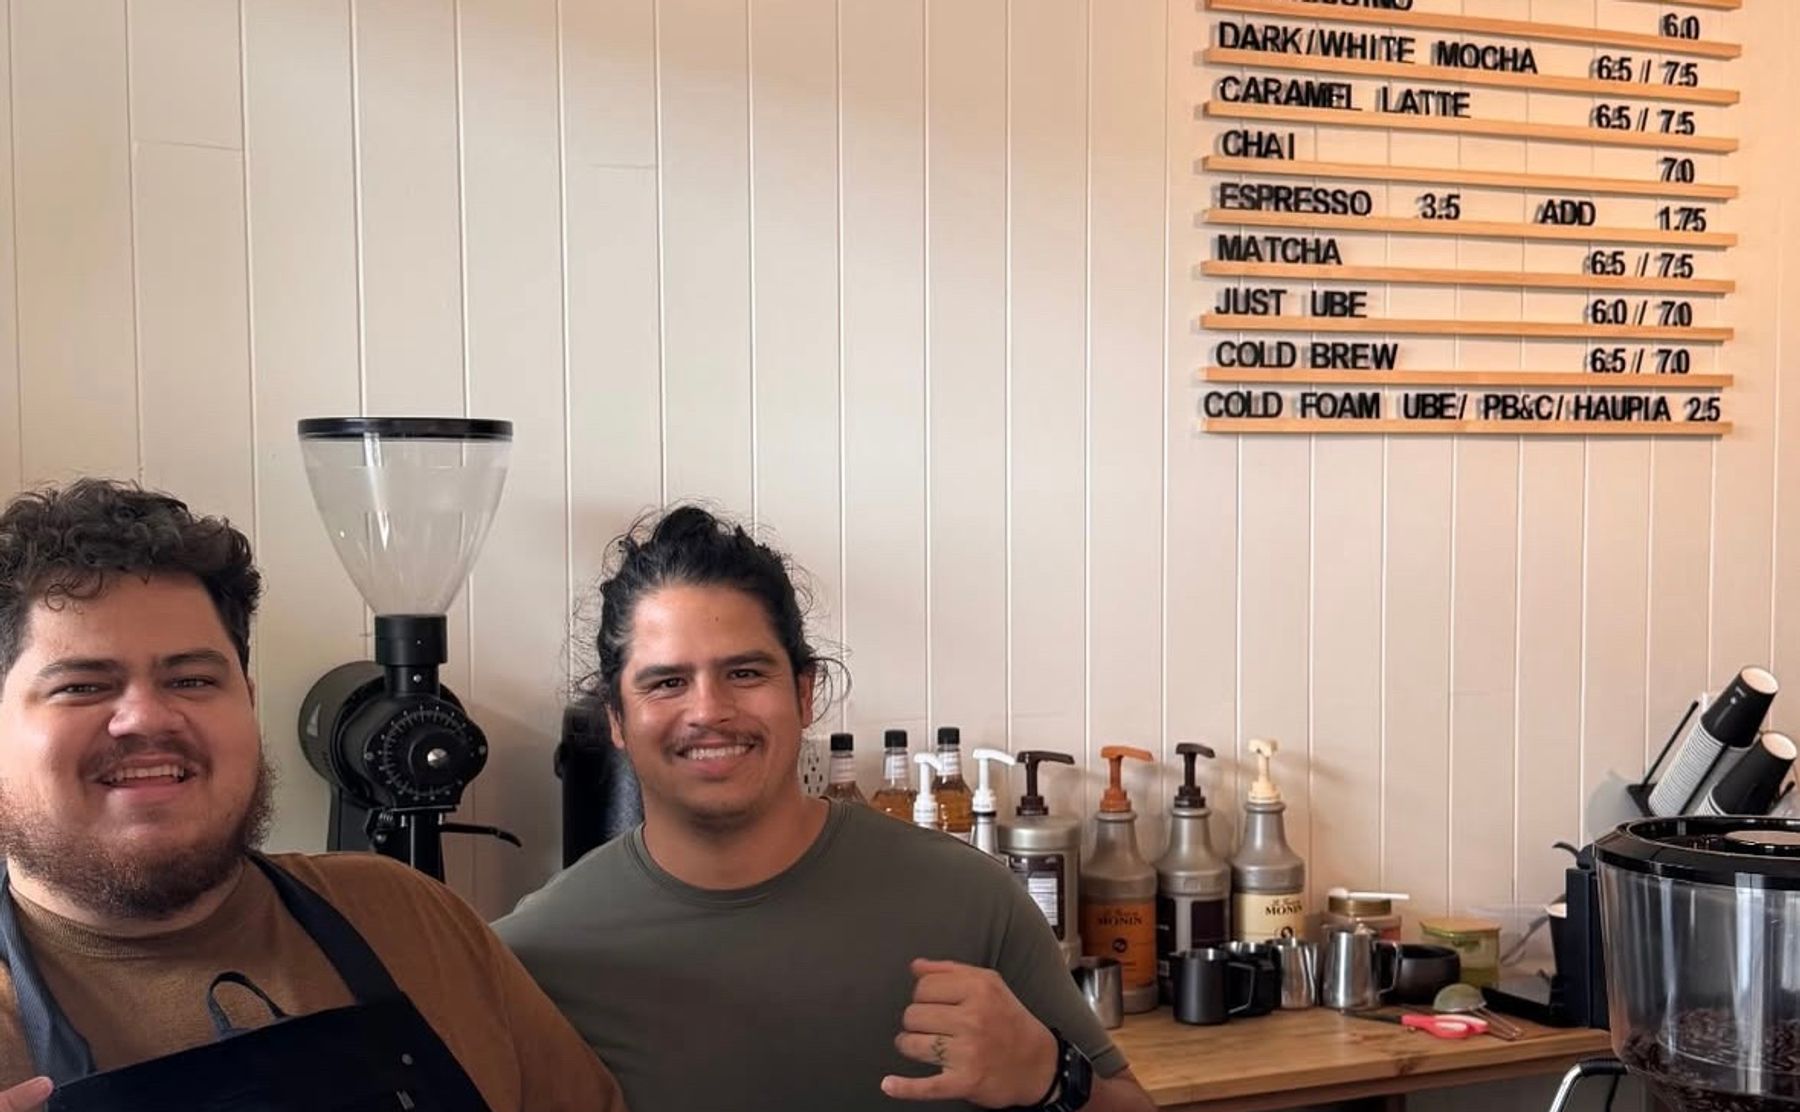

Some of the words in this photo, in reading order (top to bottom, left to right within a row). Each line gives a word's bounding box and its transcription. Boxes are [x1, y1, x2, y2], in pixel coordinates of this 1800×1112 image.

[1663, 13, 1700, 40] 6.0
[1219, 21, 1416, 63] DARK/WHITE
[1437, 40, 1538, 75] MOCHA
[1597, 55, 1633, 83] 6.5
[1664, 60, 1699, 88] 7.5
[1219, 76, 1363, 111] CARAMEL
[1381, 86, 1472, 119] LATTE
[1596, 104, 1631, 131] 6.5
[1660, 109, 1696, 136] 7.5
[1222, 129, 1295, 161] CHAI
[1661, 157, 1695, 184] 7.0
[1219, 182, 1373, 217] ESPRESSO
[1421, 193, 1461, 221] 3.5
[1541, 199, 1597, 227] ADD
[1660, 206, 1707, 233] 1.75
[1217, 234, 1343, 266] MATCHA
[1591, 250, 1626, 276] 6.5
[1661, 252, 1695, 279] 7.5
[1214, 287, 1288, 317] JUST
[1311, 290, 1368, 318] UBE
[1591, 298, 1628, 326] 6.0
[1661, 300, 1693, 327] 7.0
[1215, 340, 1297, 369] COLD
[1310, 342, 1399, 370] BREW
[1590, 348, 1626, 374] 6.5
[1658, 348, 1691, 374] 7.0
[1203, 390, 1284, 419] COLD
[1300, 392, 1381, 420] FOAM
[1573, 395, 1672, 421] HAUPIA
[1687, 396, 1721, 422] 2.5
